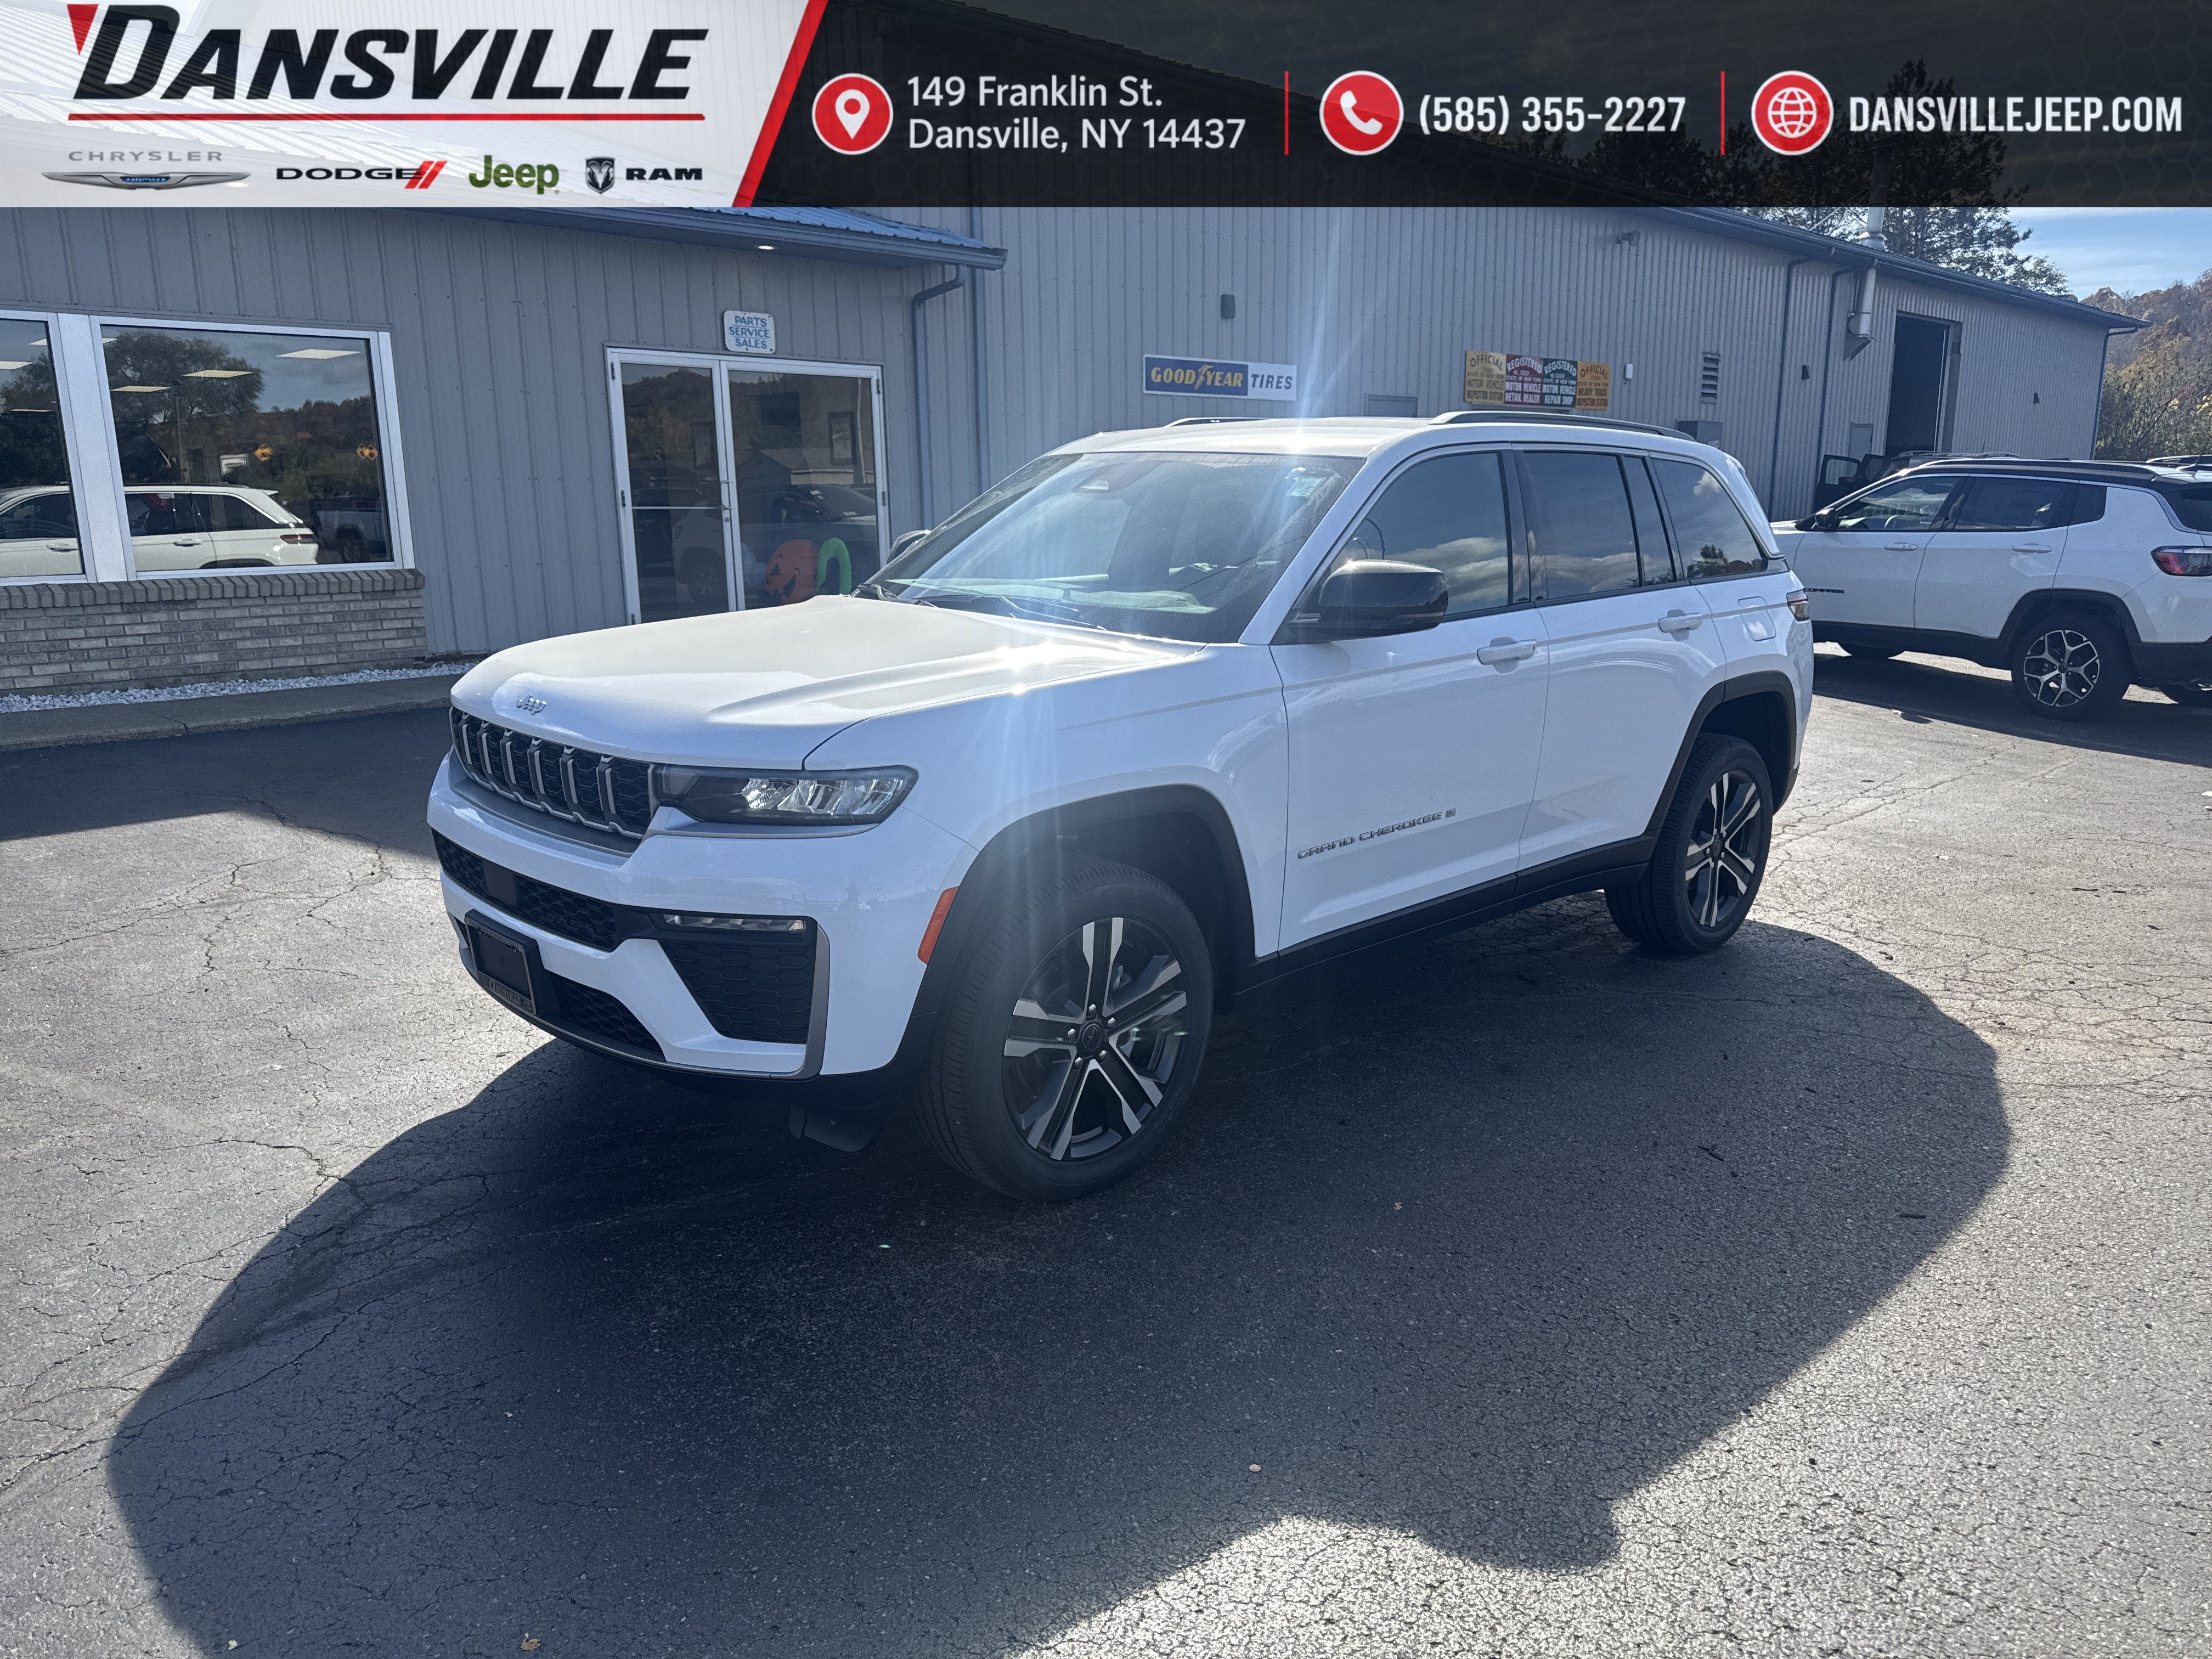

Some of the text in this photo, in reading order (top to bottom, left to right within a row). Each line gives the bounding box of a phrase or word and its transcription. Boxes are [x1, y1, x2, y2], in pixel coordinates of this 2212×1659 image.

[735, 315, 767, 327] PARTS
[729, 326, 770, 338] SERVICE
[735, 338, 768, 349] SALES
[1470, 354, 1503, 371] OFFICIAL
[1506, 356, 1543, 374] REGISTERED
[1544, 360, 1577, 377] REGISTERED
[1150, 365, 1293, 390] GOODYEAR TIRES
[1579, 364, 1607, 379] OFFICIAL
[1505, 382, 1542, 393] MOTOR VEHICLE
[1542, 384, 1576, 396] MOTOR VEHICLE
[1505, 392, 1540, 404] RETAIL DEALER
[1544, 394, 1573, 405] REPAIR SHOP
[516, 695, 546, 715] Jeep
[1298, 811, 1442, 859] GRAND CHEROKEE
